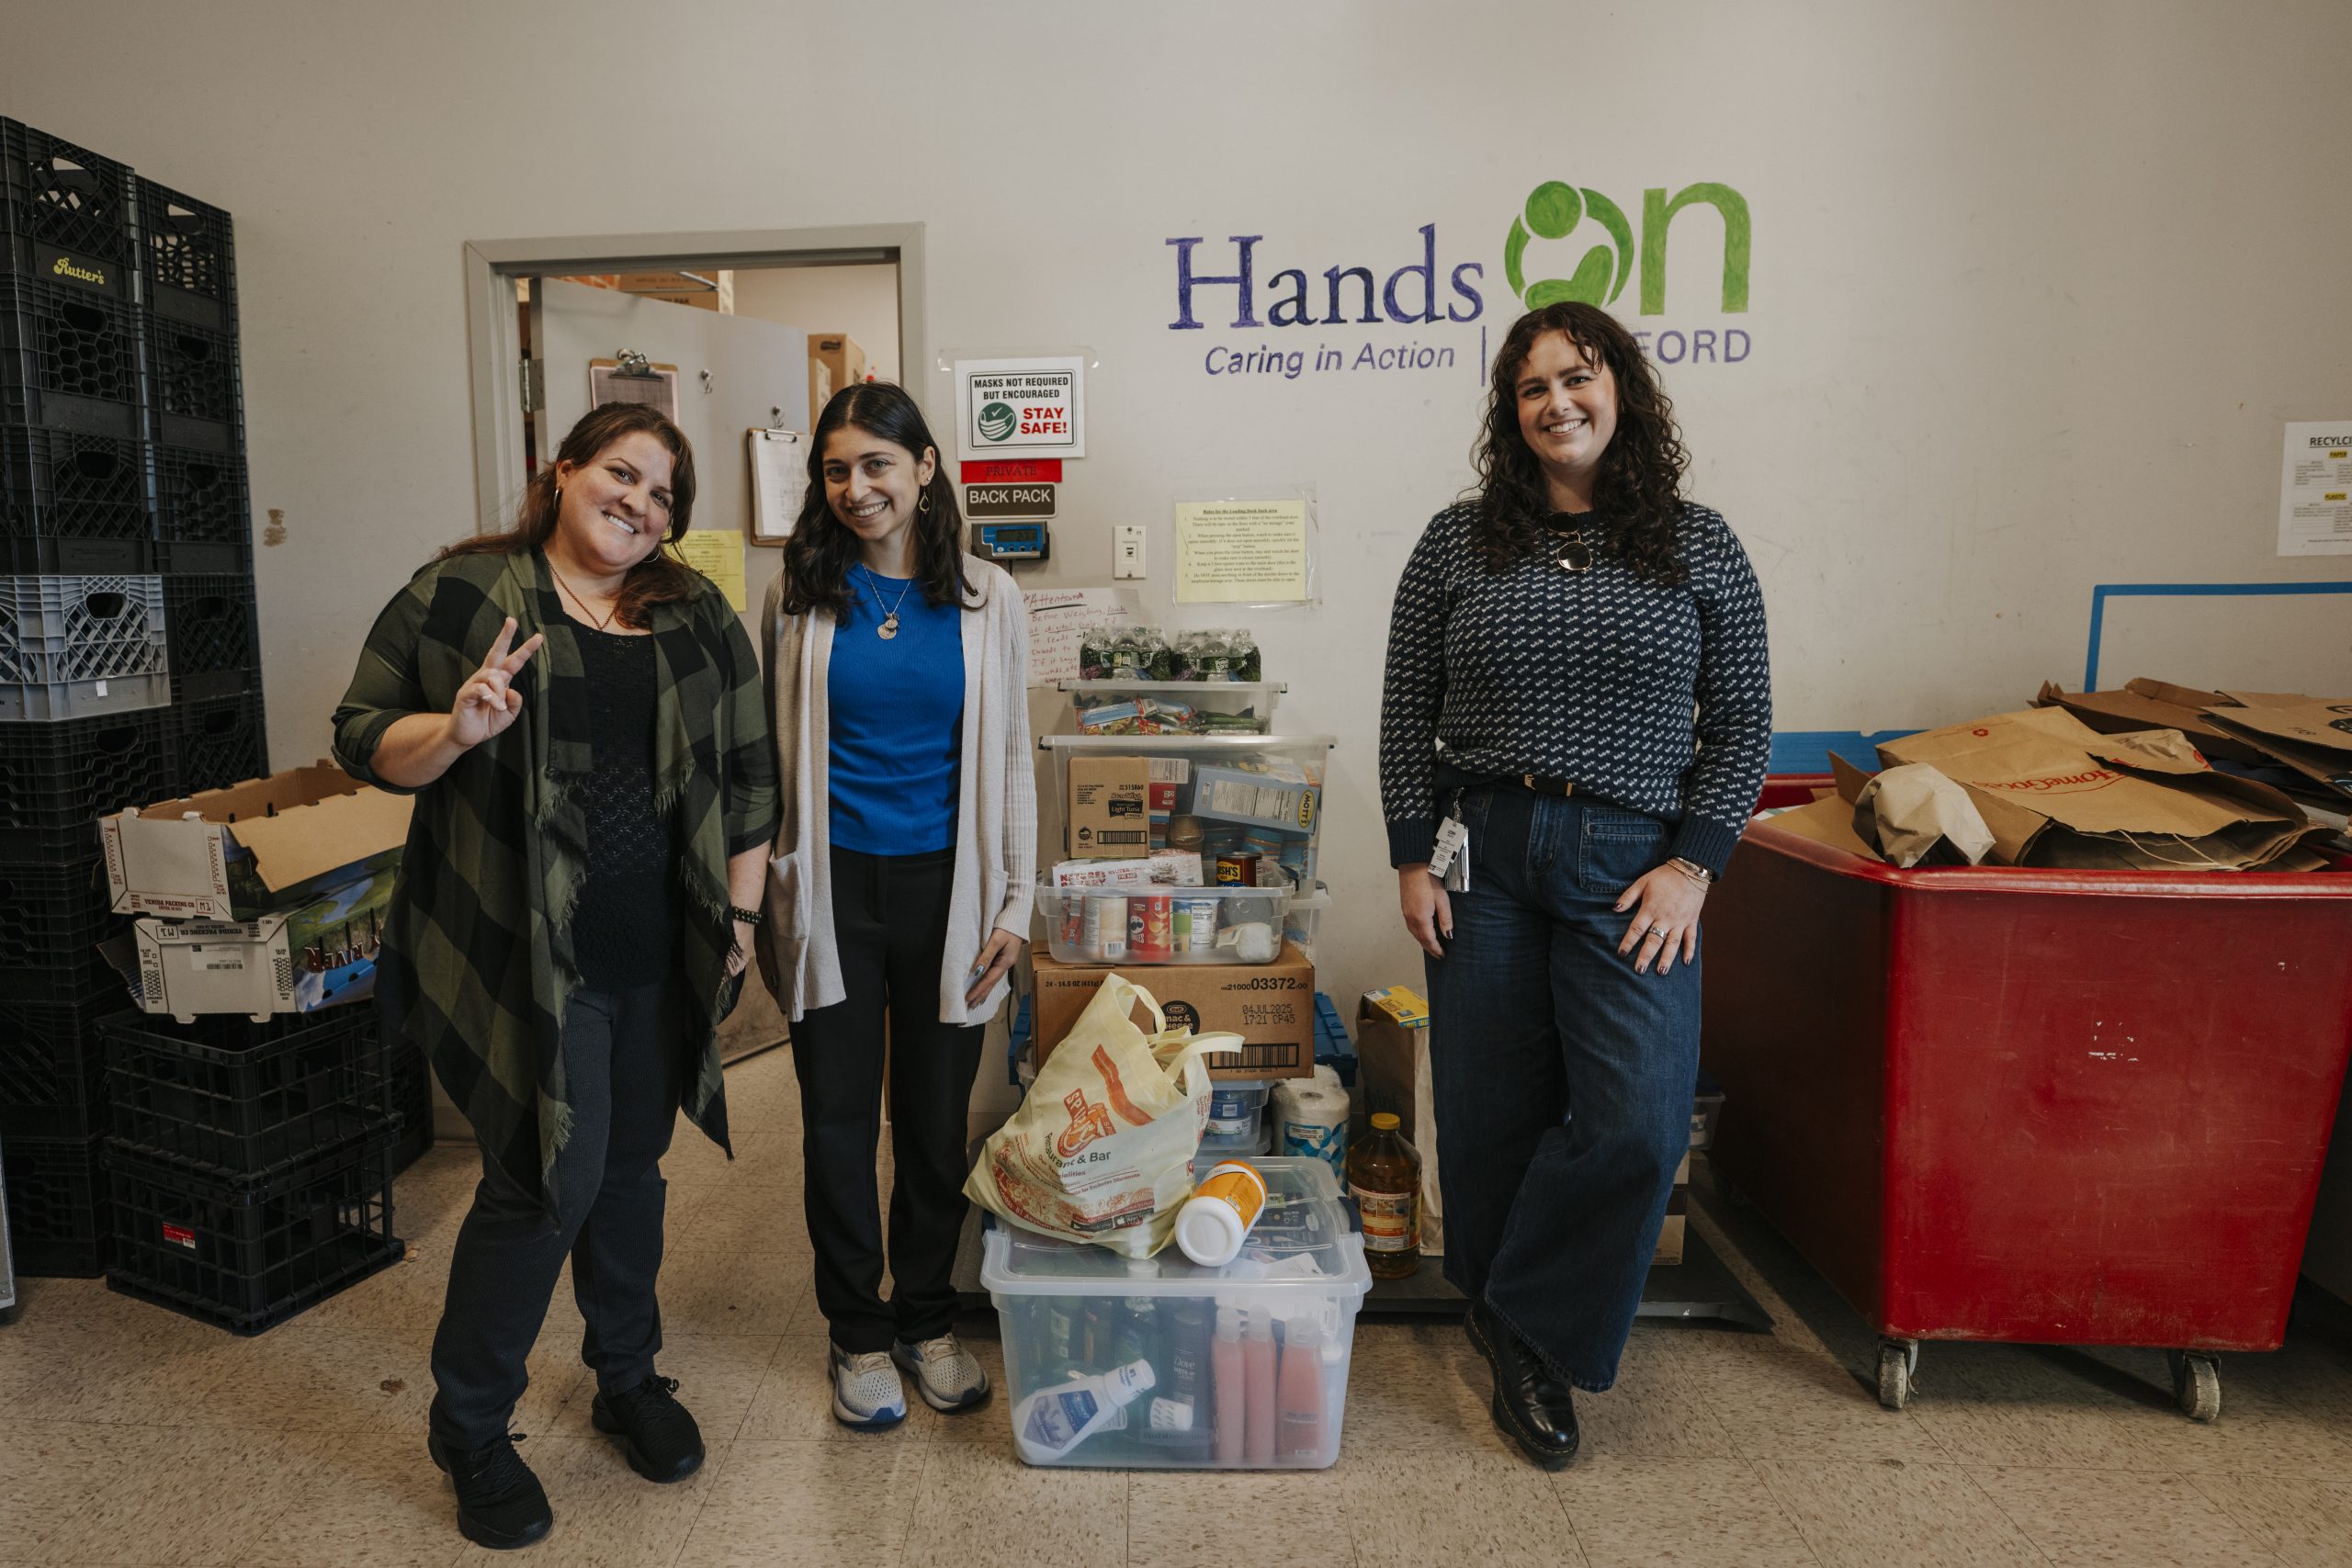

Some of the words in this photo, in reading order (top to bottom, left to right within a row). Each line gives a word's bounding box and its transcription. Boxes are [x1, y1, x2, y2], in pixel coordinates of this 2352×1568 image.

[53, 257, 105, 285] Rutter's
[1165, 223, 1485, 330] Hands
[1631, 329, 1751, 365] FORD
[1205, 344, 1305, 378] Caring
[1316, 343, 1342, 371] in
[1351, 341, 1455, 370] Action
[974, 378, 1003, 389] MASKS
[1006, 378, 1023, 387] NOT
[1025, 377, 1069, 387] REQUIRED
[983, 390, 1000, 400] BUT
[1002, 389, 1060, 400] ENCOURAGED
[1023, 407, 1065, 420] STAY
[1020, 422, 1068, 434] SAFE!
[986, 466, 1037, 476] PRIVATE
[969, 490, 1009, 503] BACK
[1012, 489, 1052, 502] PACK
[1077, 1155, 1086, 1164] &
[1090, 1151, 1112, 1162] Bar
